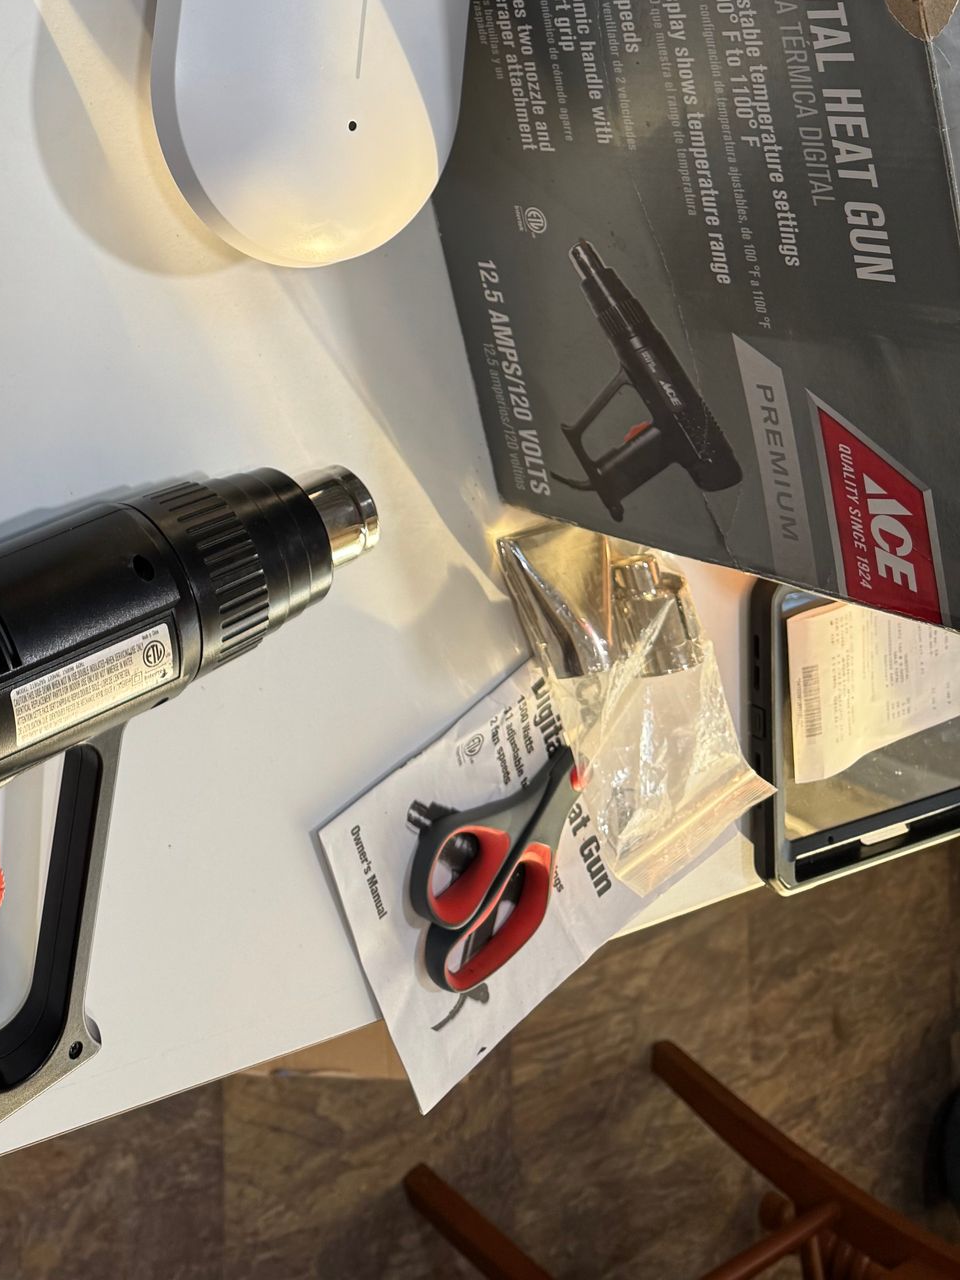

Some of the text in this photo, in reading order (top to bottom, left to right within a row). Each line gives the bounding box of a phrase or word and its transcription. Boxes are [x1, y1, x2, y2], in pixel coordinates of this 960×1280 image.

[471, 0, 489, 47] raspador
[481, 7, 501, 55] boquillas
[516, 22, 535, 56] two
[553, 14, 578, 53] grip
[601, 1, 622, 56] ventilador
[647, 7, 663, 29] que
[697, 3, 723, 78] configuración
[721, 28, 741, 44] F
[490, 56, 500, 64] y
[494, 66, 504, 80] un
[548, 46, 559, 60] de
[579, 39, 605, 100] handle
[611, 58, 624, 74] de
[654, 31, 674, 78] muestra
[673, 45, 702, 106] shows
[724, 47, 743, 68] to
[778, 21, 818, 118] TÉRMICA
[505, 51, 537, 152] attachment
[523, 59, 548, 116] nozzle
[551, 62, 568, 104] cómodo
[615, 75, 626, 84] 2
[663, 80, 677, 93] el
[713, 79, 726, 93] de
[729, 72, 758, 131] 1100°
[557, 106, 574, 142] agarre
[591, 104, 613, 146] with
[617, 86, 638, 151] velocidades
[663, 94, 681, 128] rango
[714, 94, 738, 163] temperatura
[821, 84, 878, 186] HEAT
[533, 119, 555, 154] and
[672, 129, 685, 144] de
[740, 132, 760, 149] F
[674, 147, 698, 217] temperatura
[682, 110, 724, 228] temperature
[744, 62, 786, 185] temperature
[768, 187, 804, 268] settings
[797, 123, 835, 207] DIGITAL
[726, 164, 751, 224] ajustables,
[740, 225, 753, 240] de
[743, 243, 757, 262] 100
[843, 197, 895, 282] GUN
[704, 230, 731, 286] range
[749, 278, 759, 286] a
[751, 288, 767, 314] 1100
[476, 258, 551, 499] 12.5 AMPS/120 VOLTS
[658, 381, 682, 406] ACE
[481, 341, 527, 491] 12.5 amperios/120 voltios
[755, 384, 798, 541] PREMIUM
[837, 443, 859, 502] QUALITY
[848, 506, 866, 550] SINCE
[863, 473, 917, 592] ACE
[855, 555, 872, 589] 1924
[516, 694, 535, 754] 1500 Watts
[488, 715, 512, 786] 2 fan speeds
[505, 721, 525, 777] adjustable
[530, 677, 567, 760] Digita
[576, 833, 617, 898] Gun
[350, 824, 388, 920] Owner's Manual
